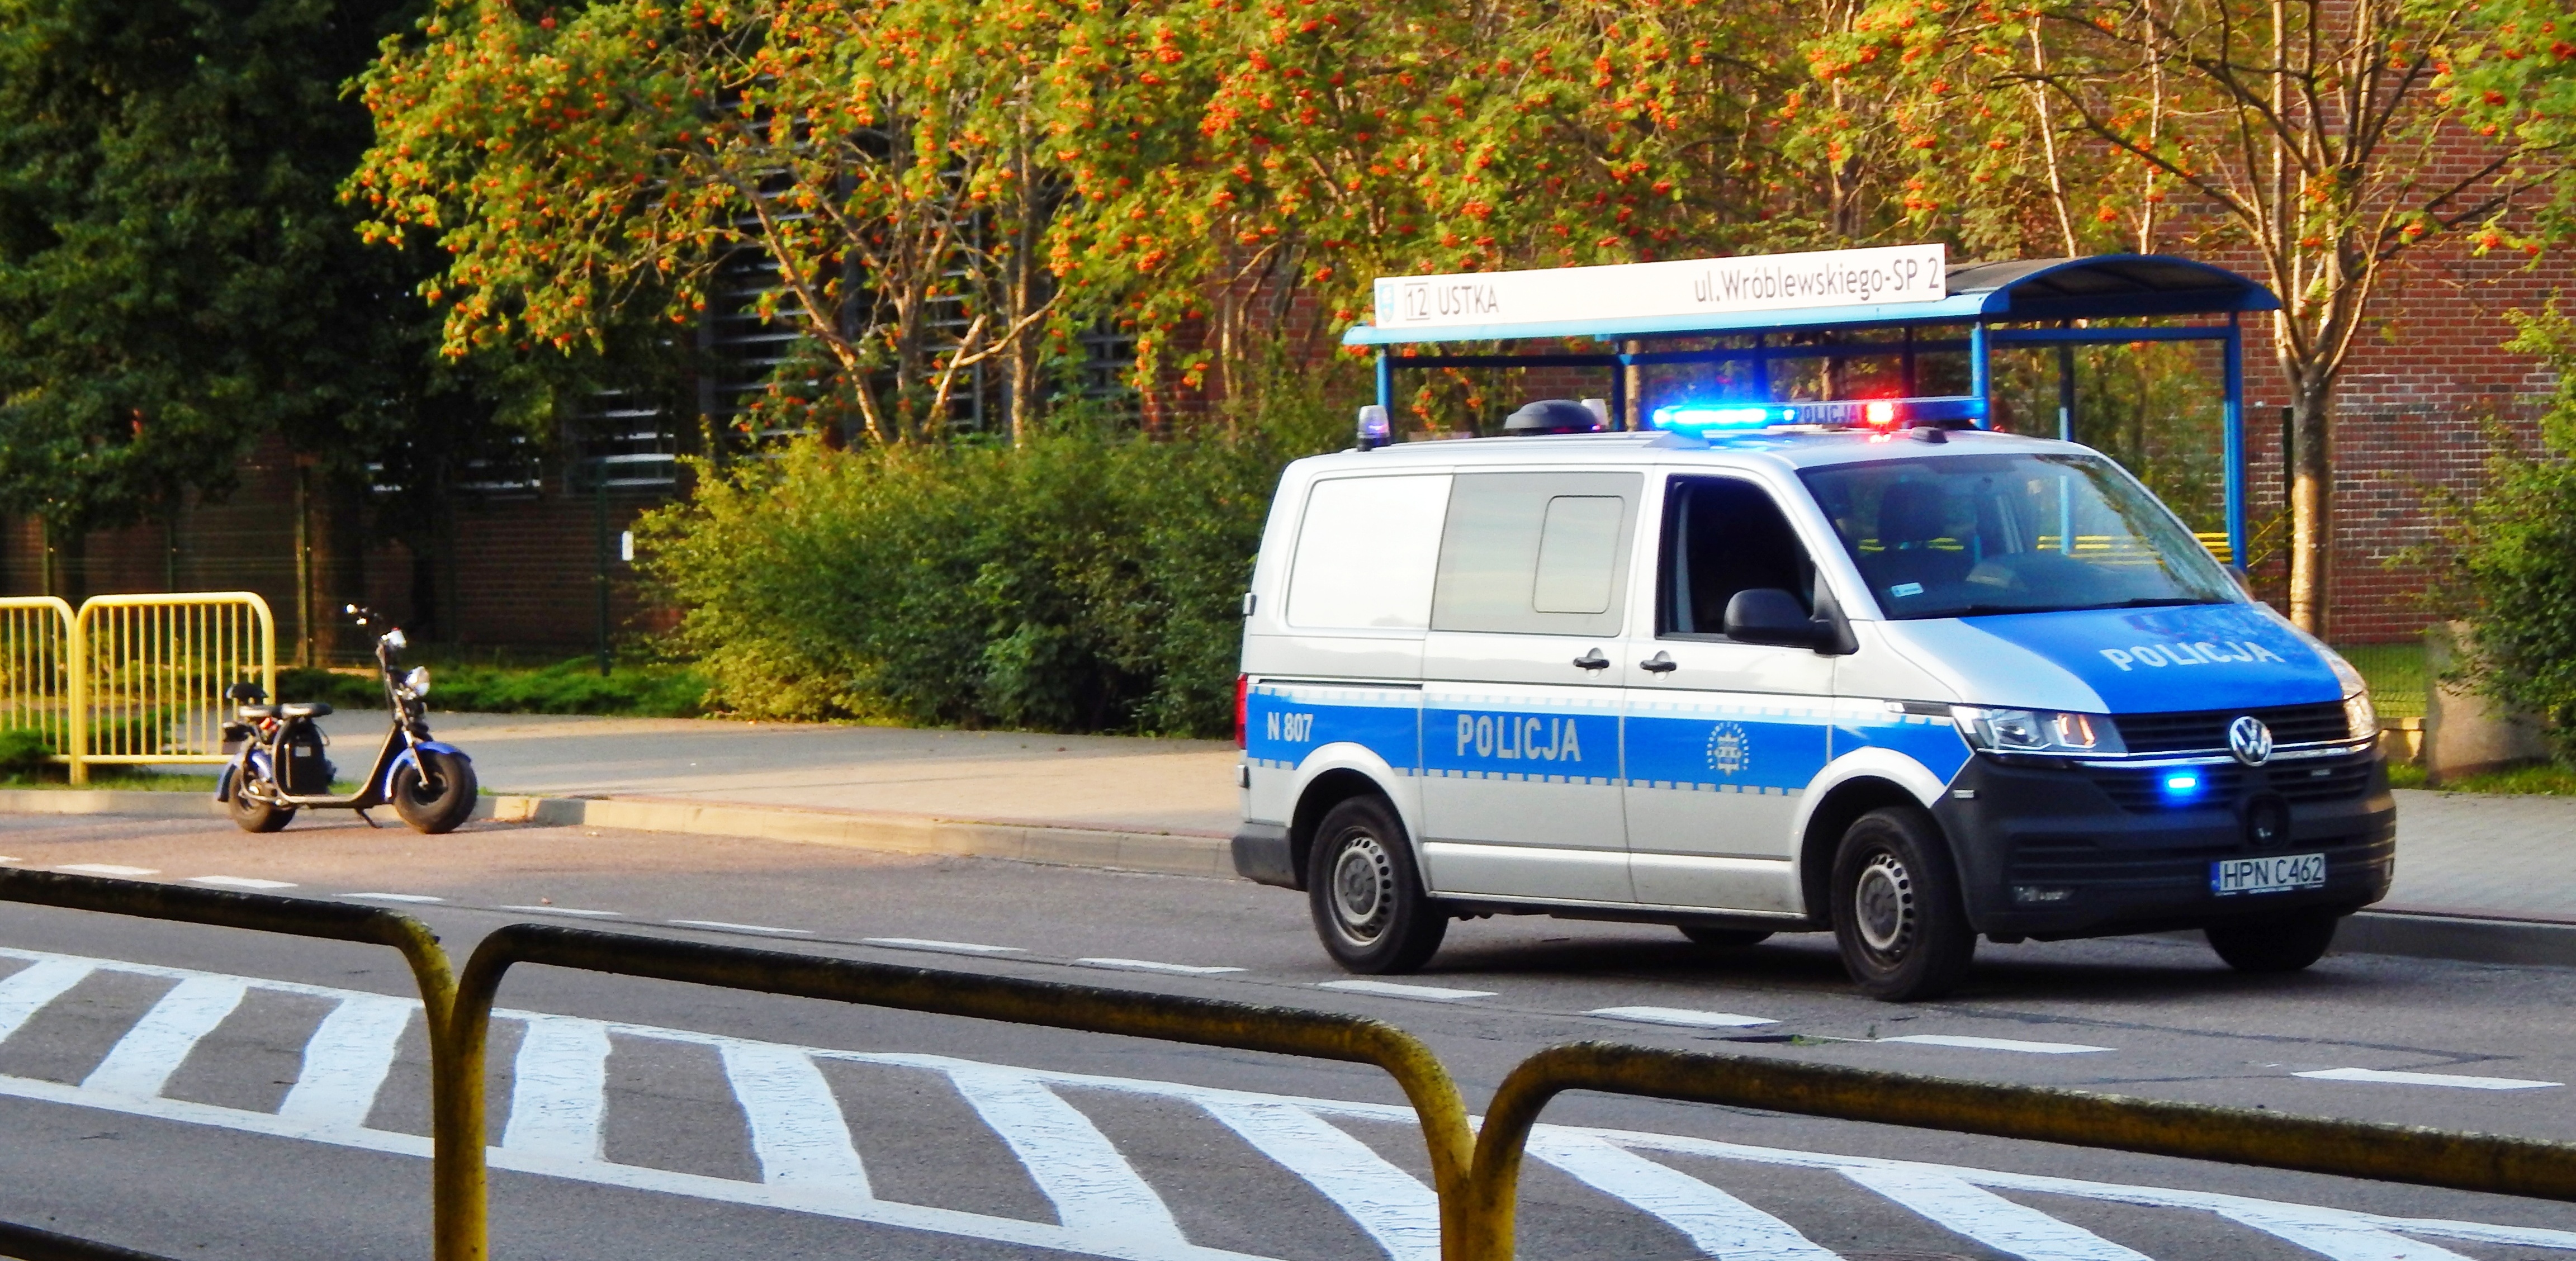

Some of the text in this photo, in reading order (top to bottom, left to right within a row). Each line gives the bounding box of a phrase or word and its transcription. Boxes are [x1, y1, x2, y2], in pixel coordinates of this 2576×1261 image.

[1928, 257, 1940, 289] 2
[1407, 284, 1500, 316] 12 USTKA
[2099, 641, 2286, 672] POLICJA
[1267, 711, 1314, 742] N 807
[1457, 714, 1581, 762] POLICJA
[2224, 856, 2323, 888] HPN C462
